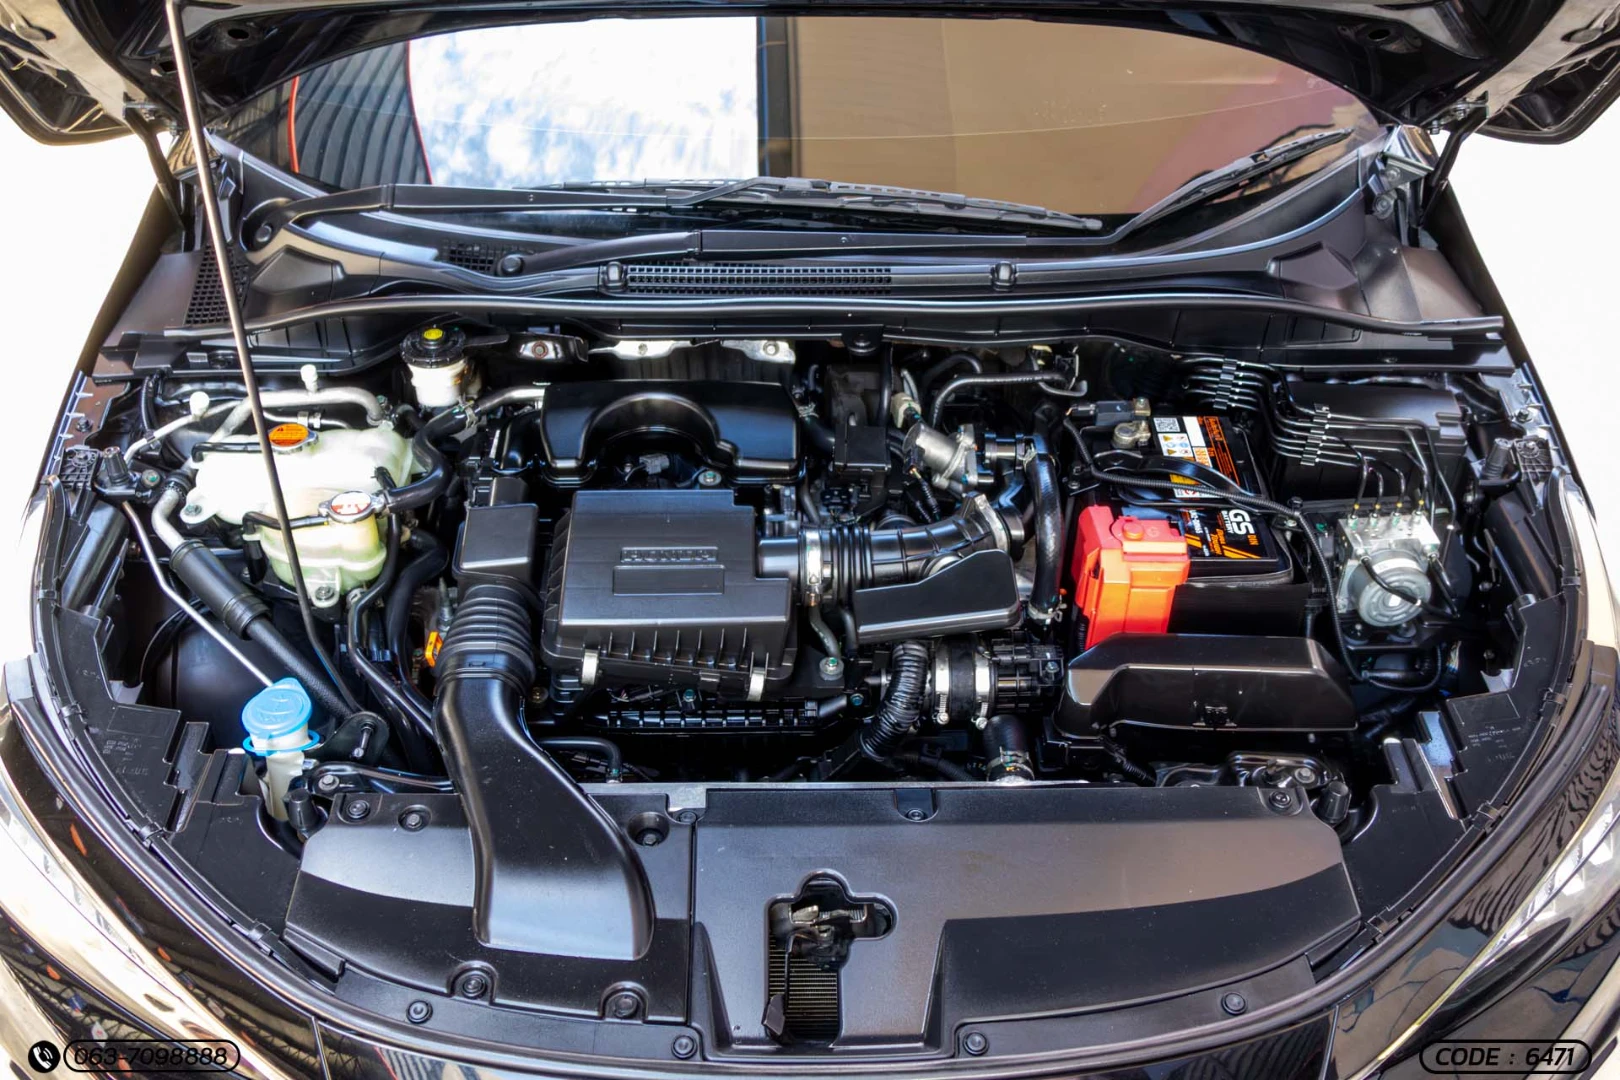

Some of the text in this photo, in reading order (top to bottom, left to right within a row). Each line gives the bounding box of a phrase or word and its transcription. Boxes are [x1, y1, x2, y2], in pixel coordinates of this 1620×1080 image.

[1221, 510, 1235, 534] BATTERY
[1228, 508, 1256, 535] GS
[1247, 534, 1259, 546] DIN
